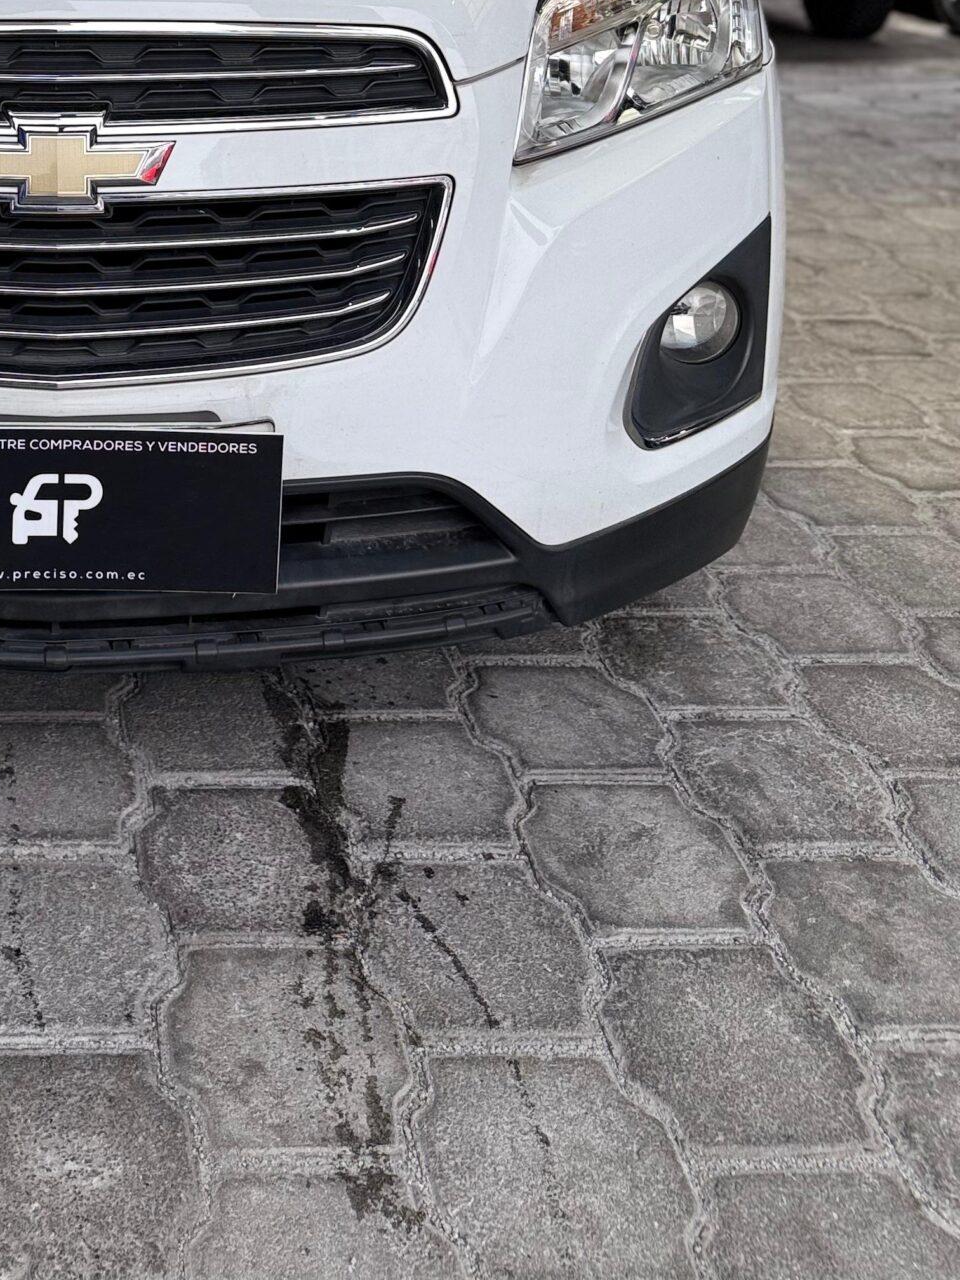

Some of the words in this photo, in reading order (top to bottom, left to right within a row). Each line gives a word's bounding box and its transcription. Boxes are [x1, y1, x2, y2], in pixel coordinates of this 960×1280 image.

[29, 438, 143, 452] COMPRADORES
[146, 441, 156, 452] Y
[158, 440, 258, 455] VENDEDORES
